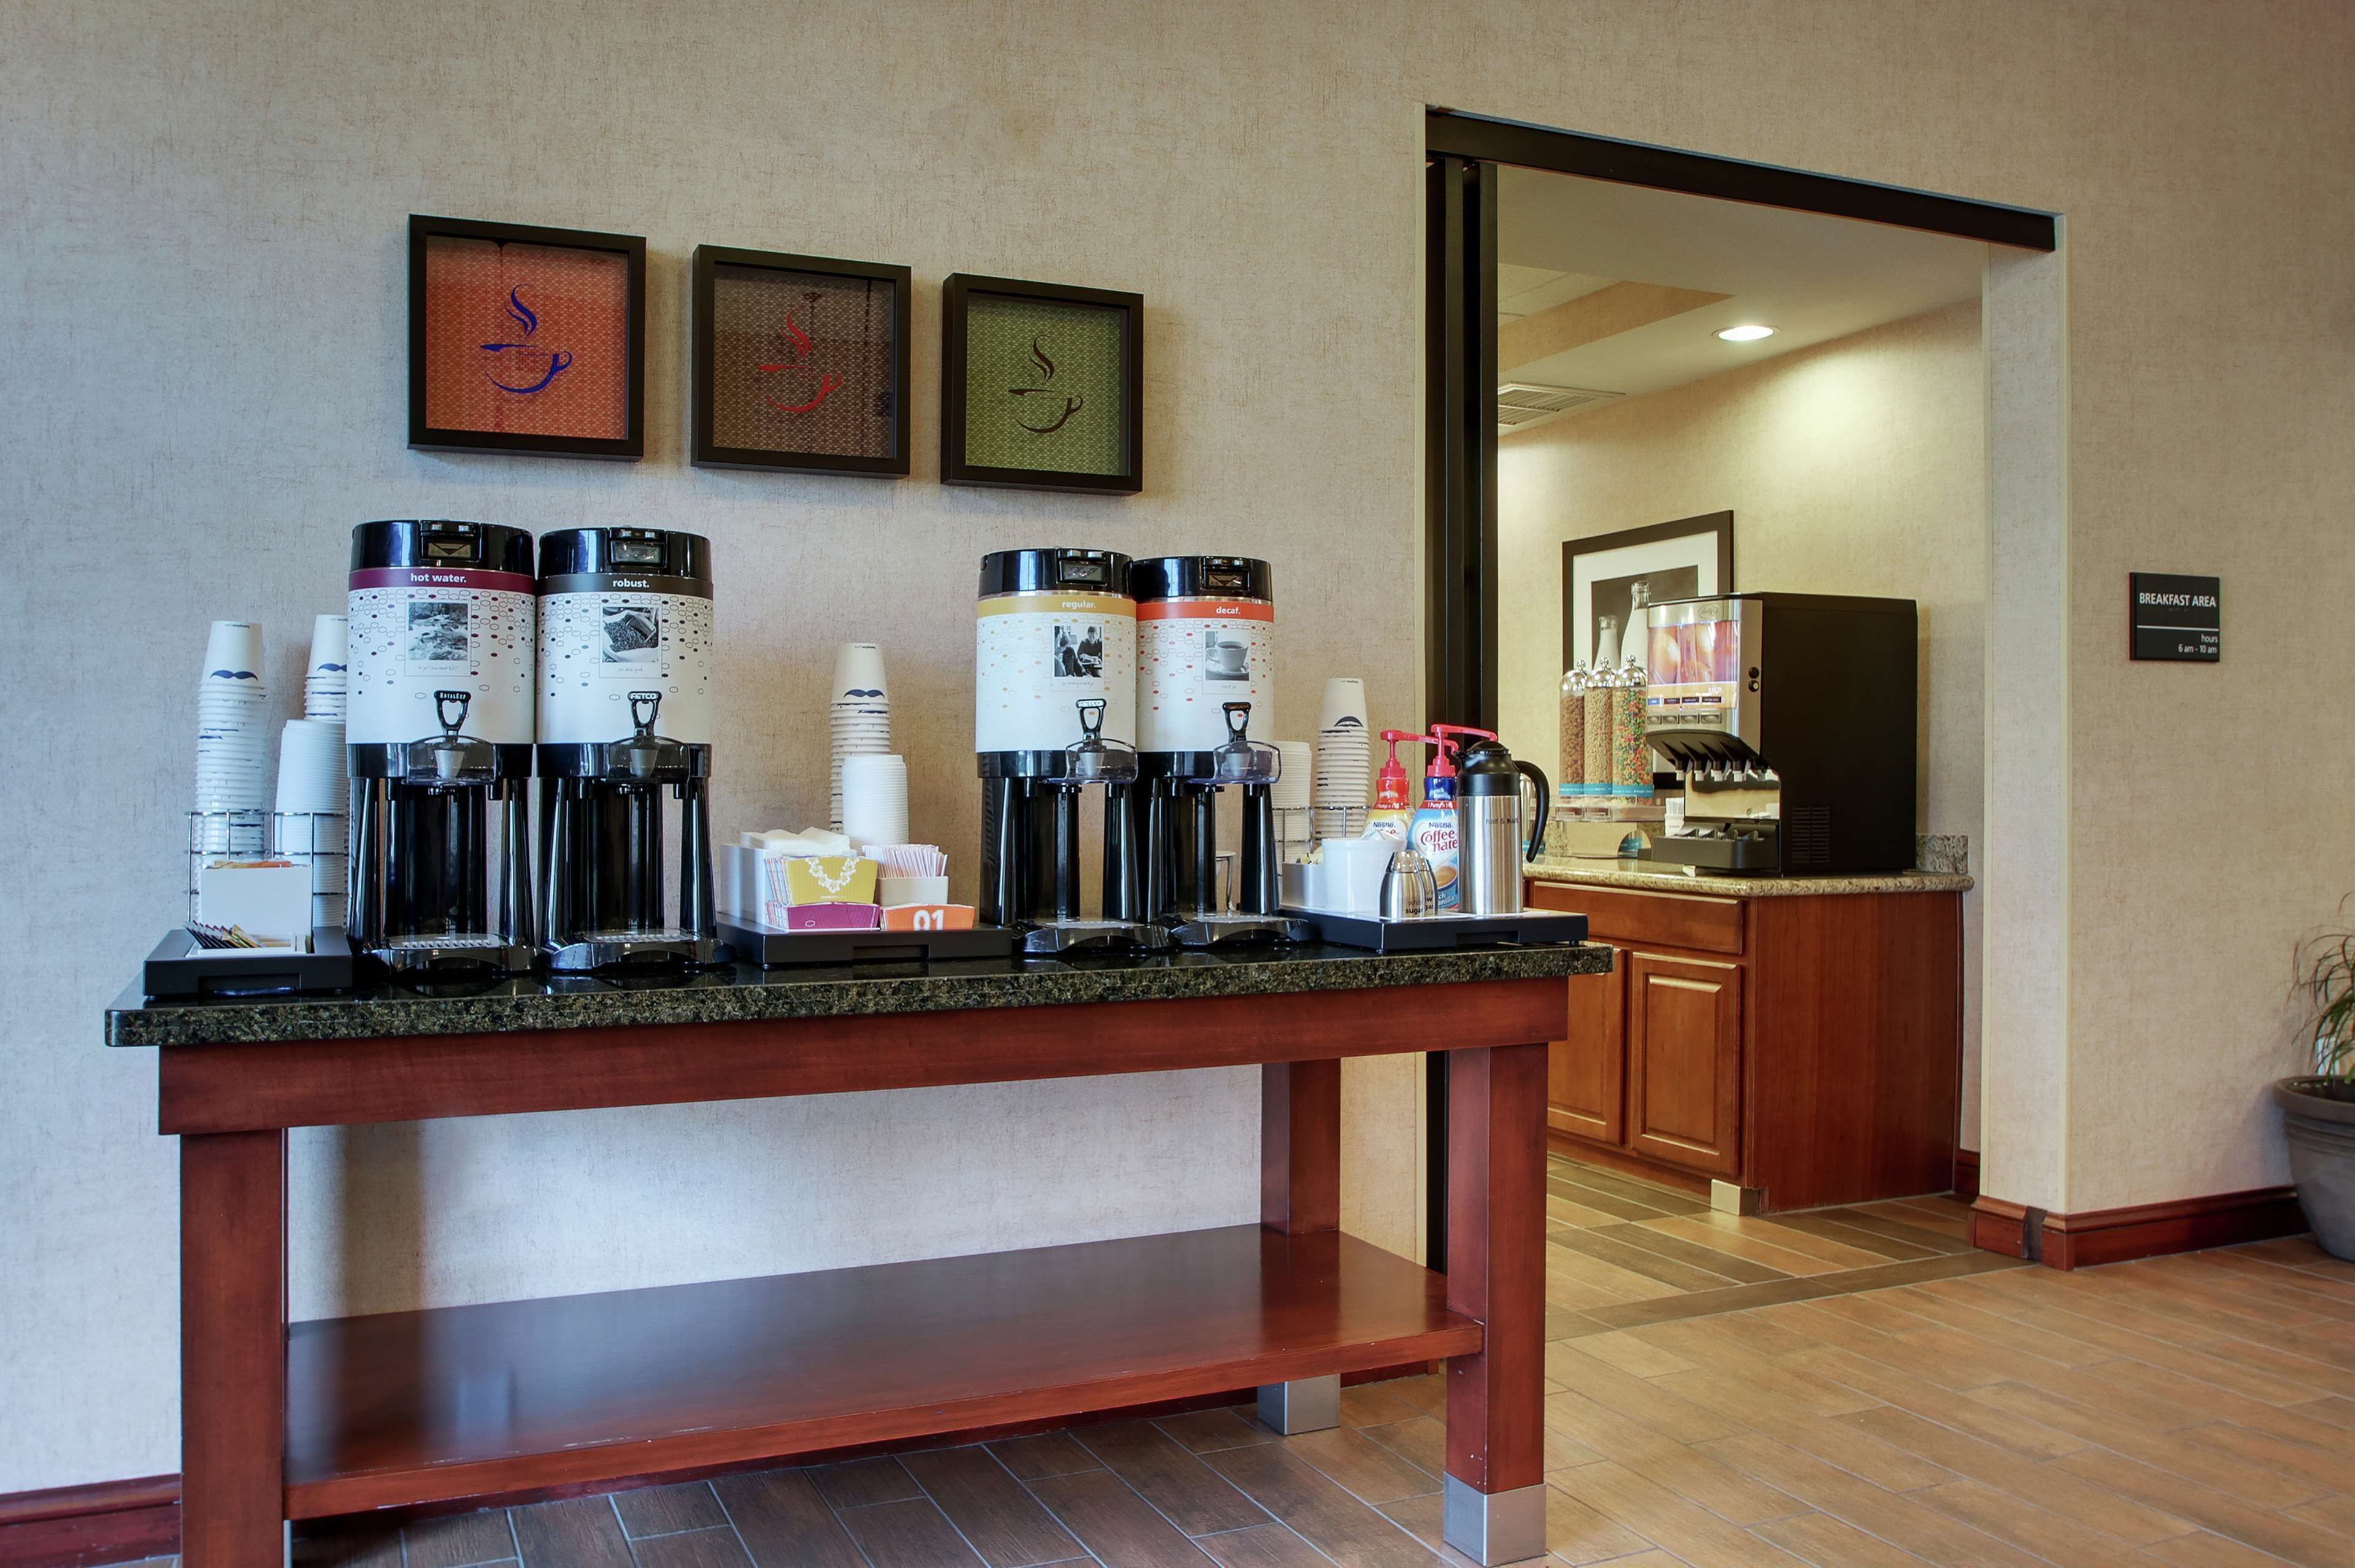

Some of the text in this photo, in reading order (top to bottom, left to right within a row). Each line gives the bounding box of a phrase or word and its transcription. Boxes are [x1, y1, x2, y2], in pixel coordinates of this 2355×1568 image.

[410, 573, 467, 583] hot water.
[612, 578, 650, 588] robust.
[1062, 601, 1097, 609] regular.
[2139, 593, 2217, 608] BREAKFAST AREA
[2201, 634, 2218, 643] hours
[2178, 644, 2183, 653] 6
